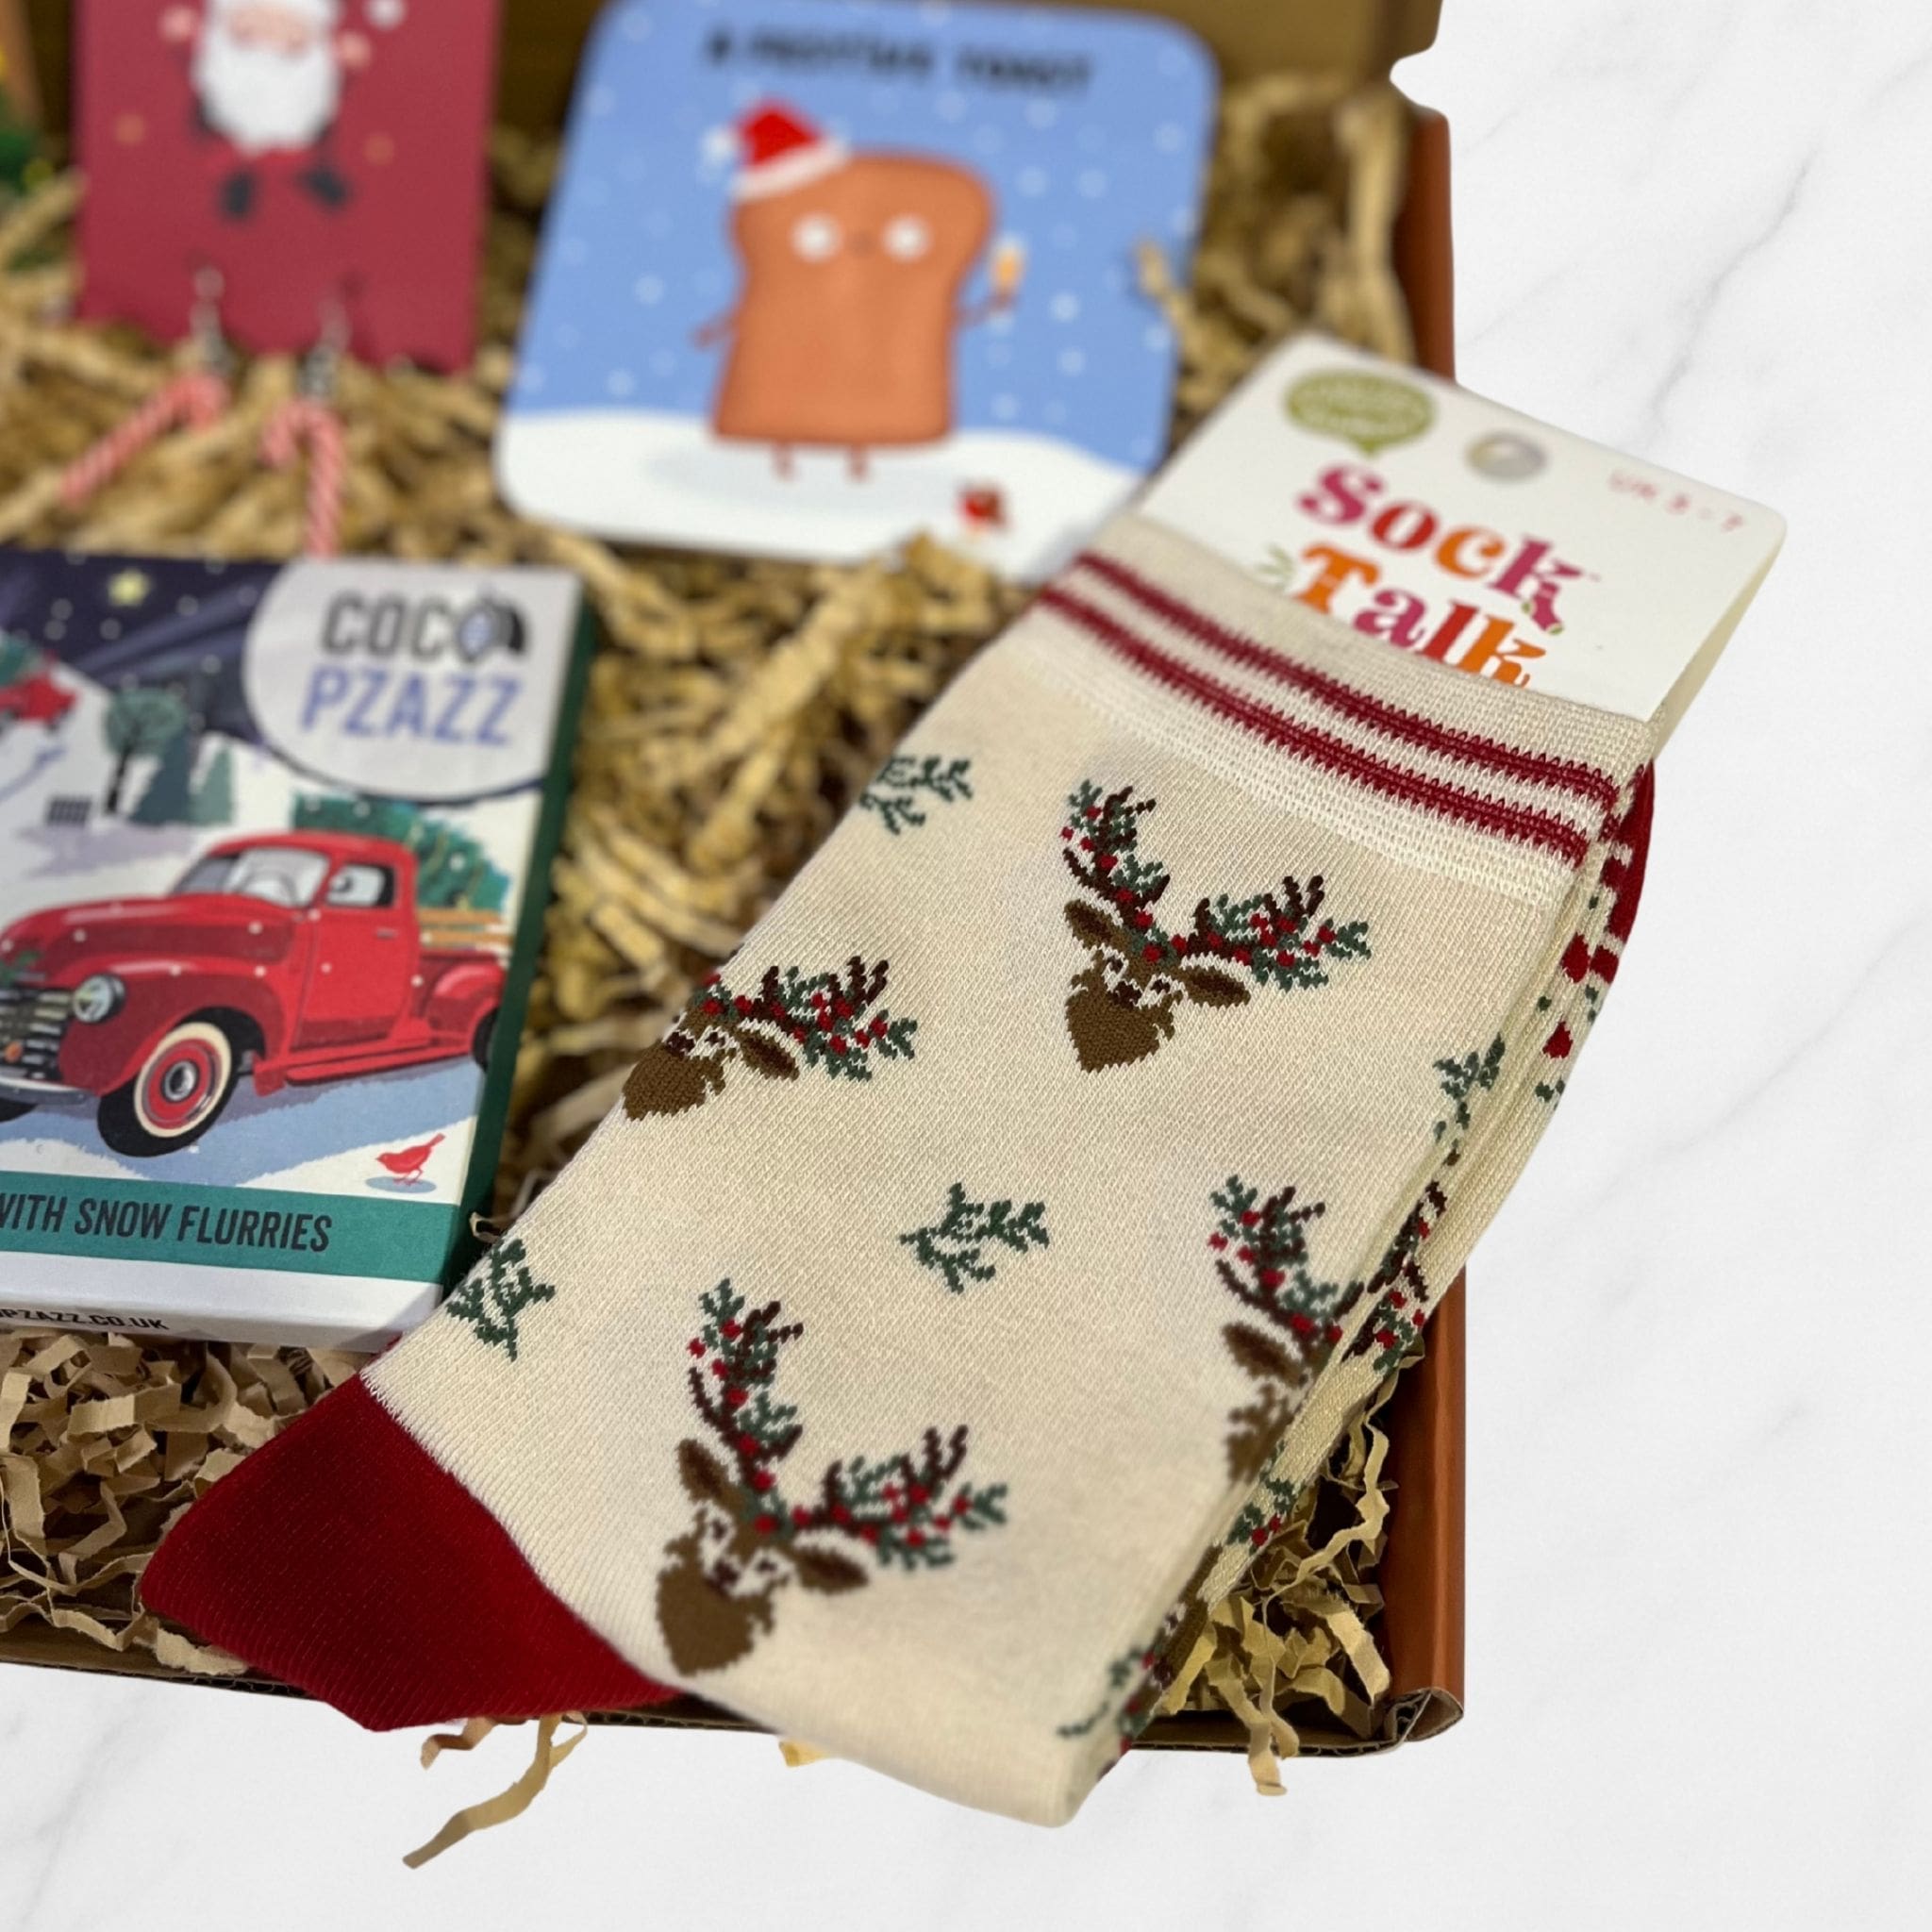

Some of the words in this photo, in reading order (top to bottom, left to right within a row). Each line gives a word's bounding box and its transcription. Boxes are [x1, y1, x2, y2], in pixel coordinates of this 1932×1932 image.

[1295, 461, 1585, 635] Sock
[1292, 540, 1547, 690] Talk
[299, 665, 522, 745] PZAZZ
[75, 1197, 173, 1241] SNOW
[176, 1205, 332, 1252] FLURRIES
